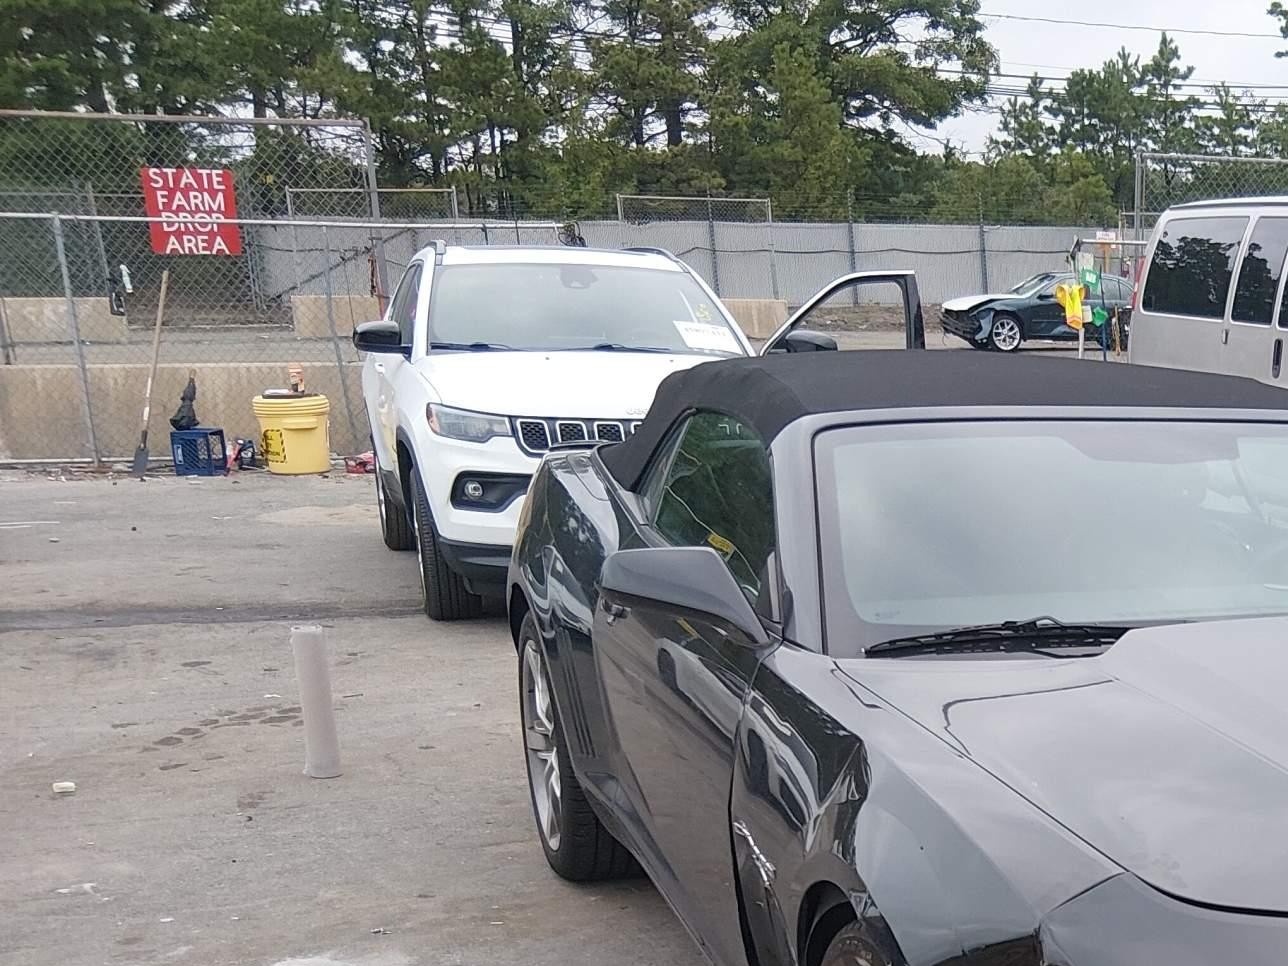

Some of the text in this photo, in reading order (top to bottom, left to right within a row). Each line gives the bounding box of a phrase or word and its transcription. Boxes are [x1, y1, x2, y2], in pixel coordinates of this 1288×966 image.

[148, 167, 226, 189] STATE
[156, 190, 225, 211] FARM
[161, 211, 226, 232] DROP
[165, 234, 231, 255] AREA
